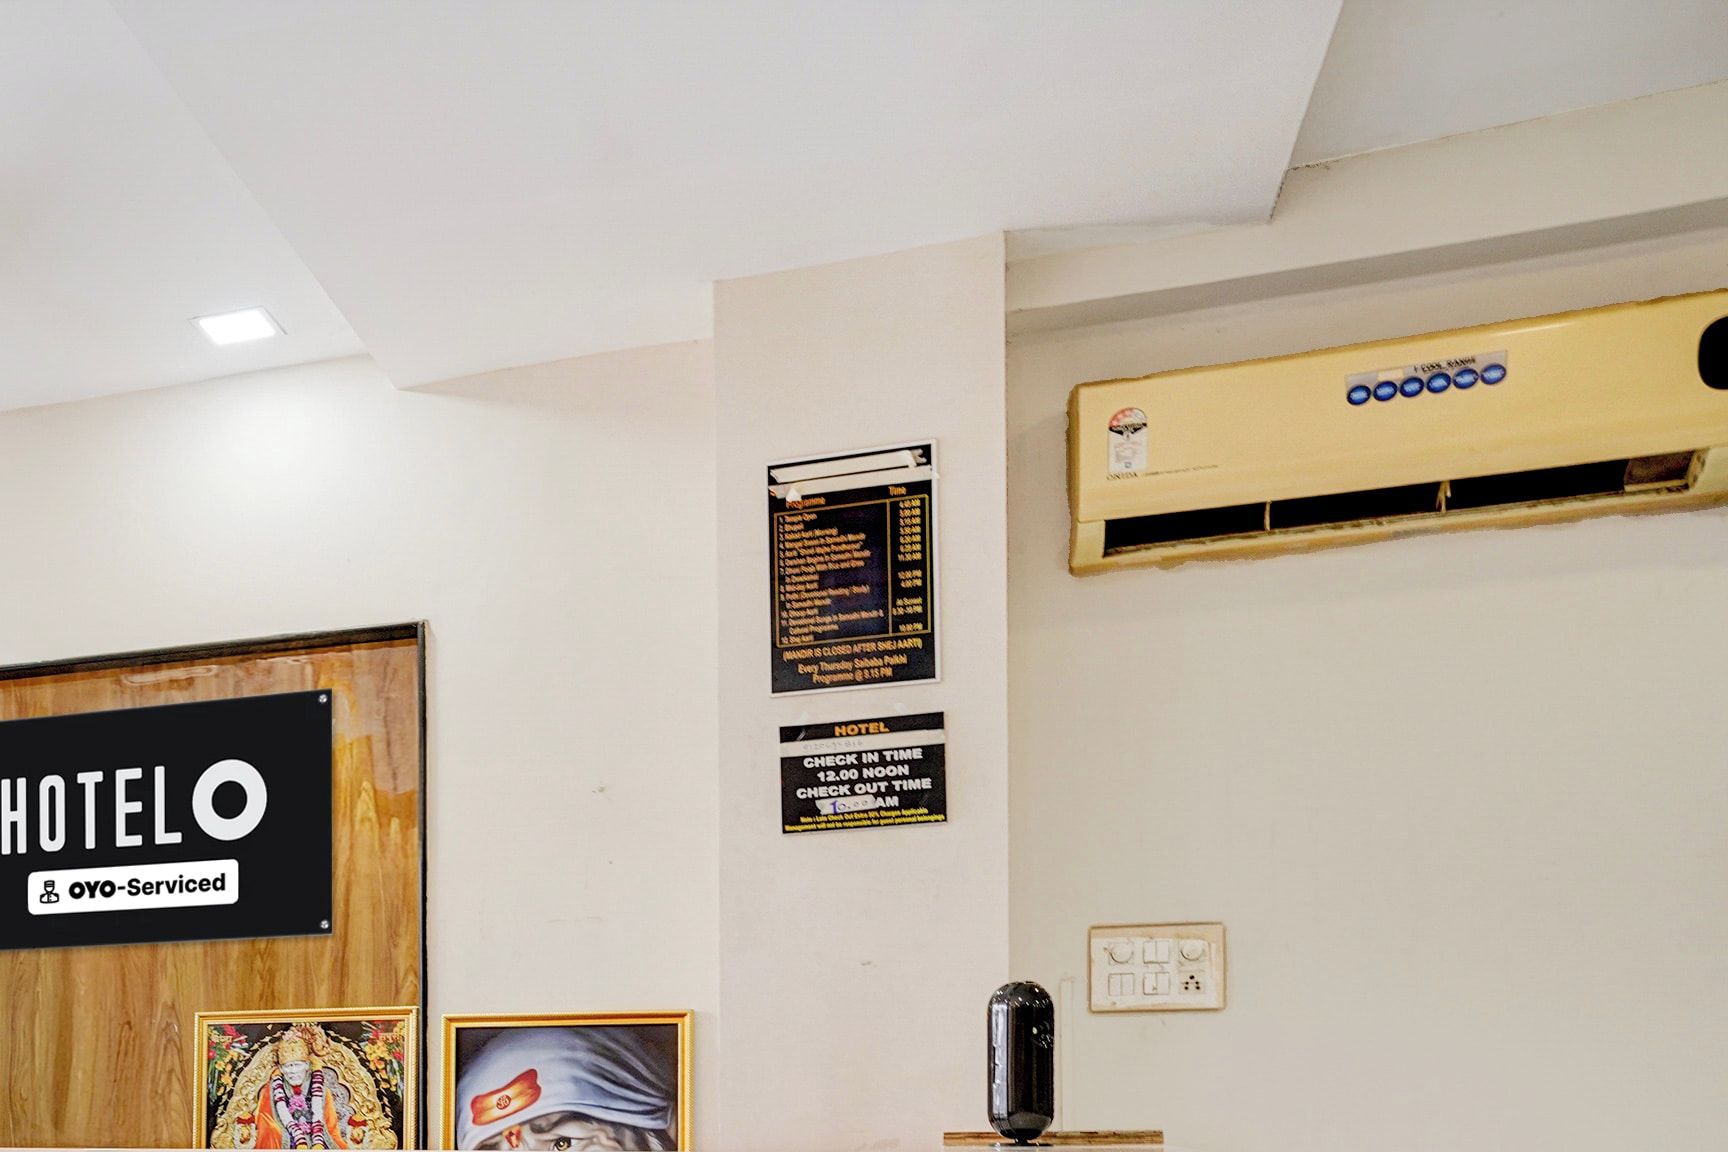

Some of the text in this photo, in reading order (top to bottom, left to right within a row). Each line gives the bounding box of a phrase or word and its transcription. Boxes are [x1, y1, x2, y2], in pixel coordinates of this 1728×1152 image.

[798, 663, 819, 675] Every
[820, 660, 853, 672] Thursday
[834, 722, 890, 736] HOTEL
[803, 748, 923, 768] CHECK IN TIME
[817, 765, 909, 782] 12.00 NOON
[796, 778, 932, 799] CHECK OUT TIME
[0, 766, 182, 855] HOTEL
[874, 796, 900, 808] AM
[69, 873, 226, 899] OYO-Serviced
